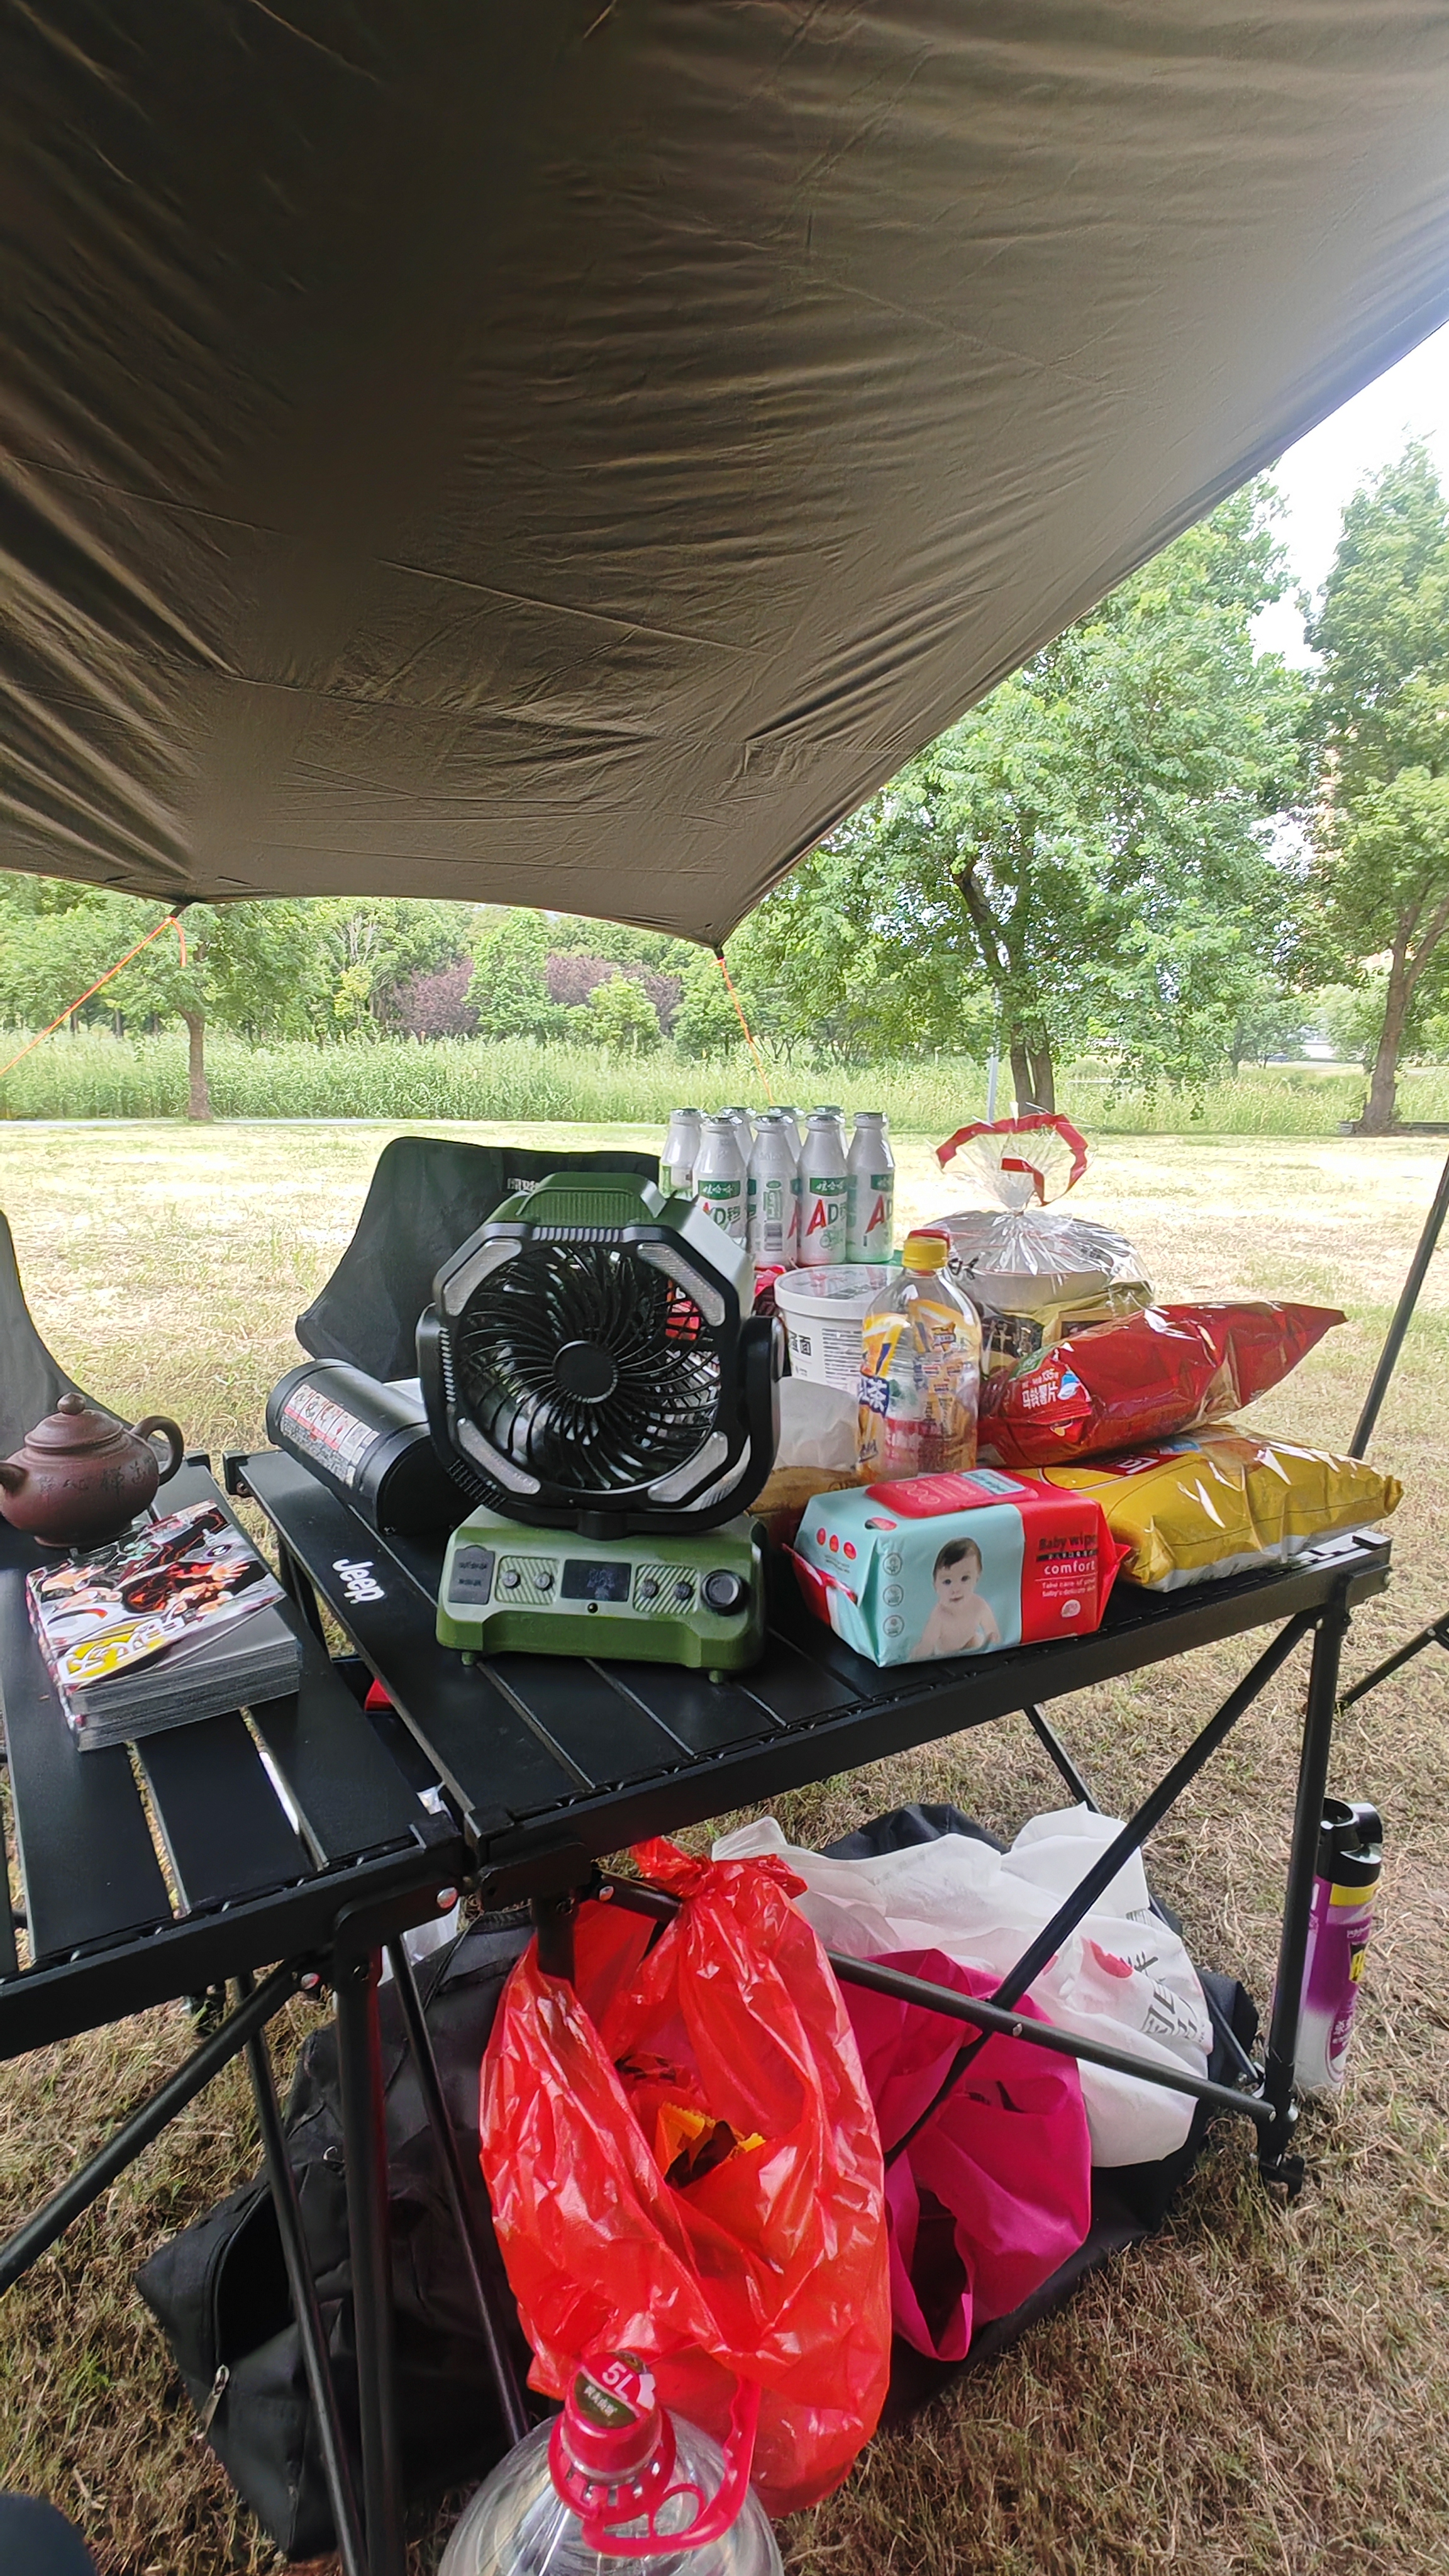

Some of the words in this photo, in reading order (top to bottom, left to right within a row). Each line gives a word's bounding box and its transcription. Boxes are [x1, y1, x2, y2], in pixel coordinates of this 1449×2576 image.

[1021, 1381, 1058, 1409] 马铃薯片
[1039, 1535, 1067, 1552] Baby
[332, 1559, 385, 1602] Jeep
[1044, 1560, 1096, 1575] comfort
[57, 1602, 186, 1685] 鬼灭之刃
[602, 2361, 634, 2401] 5L
